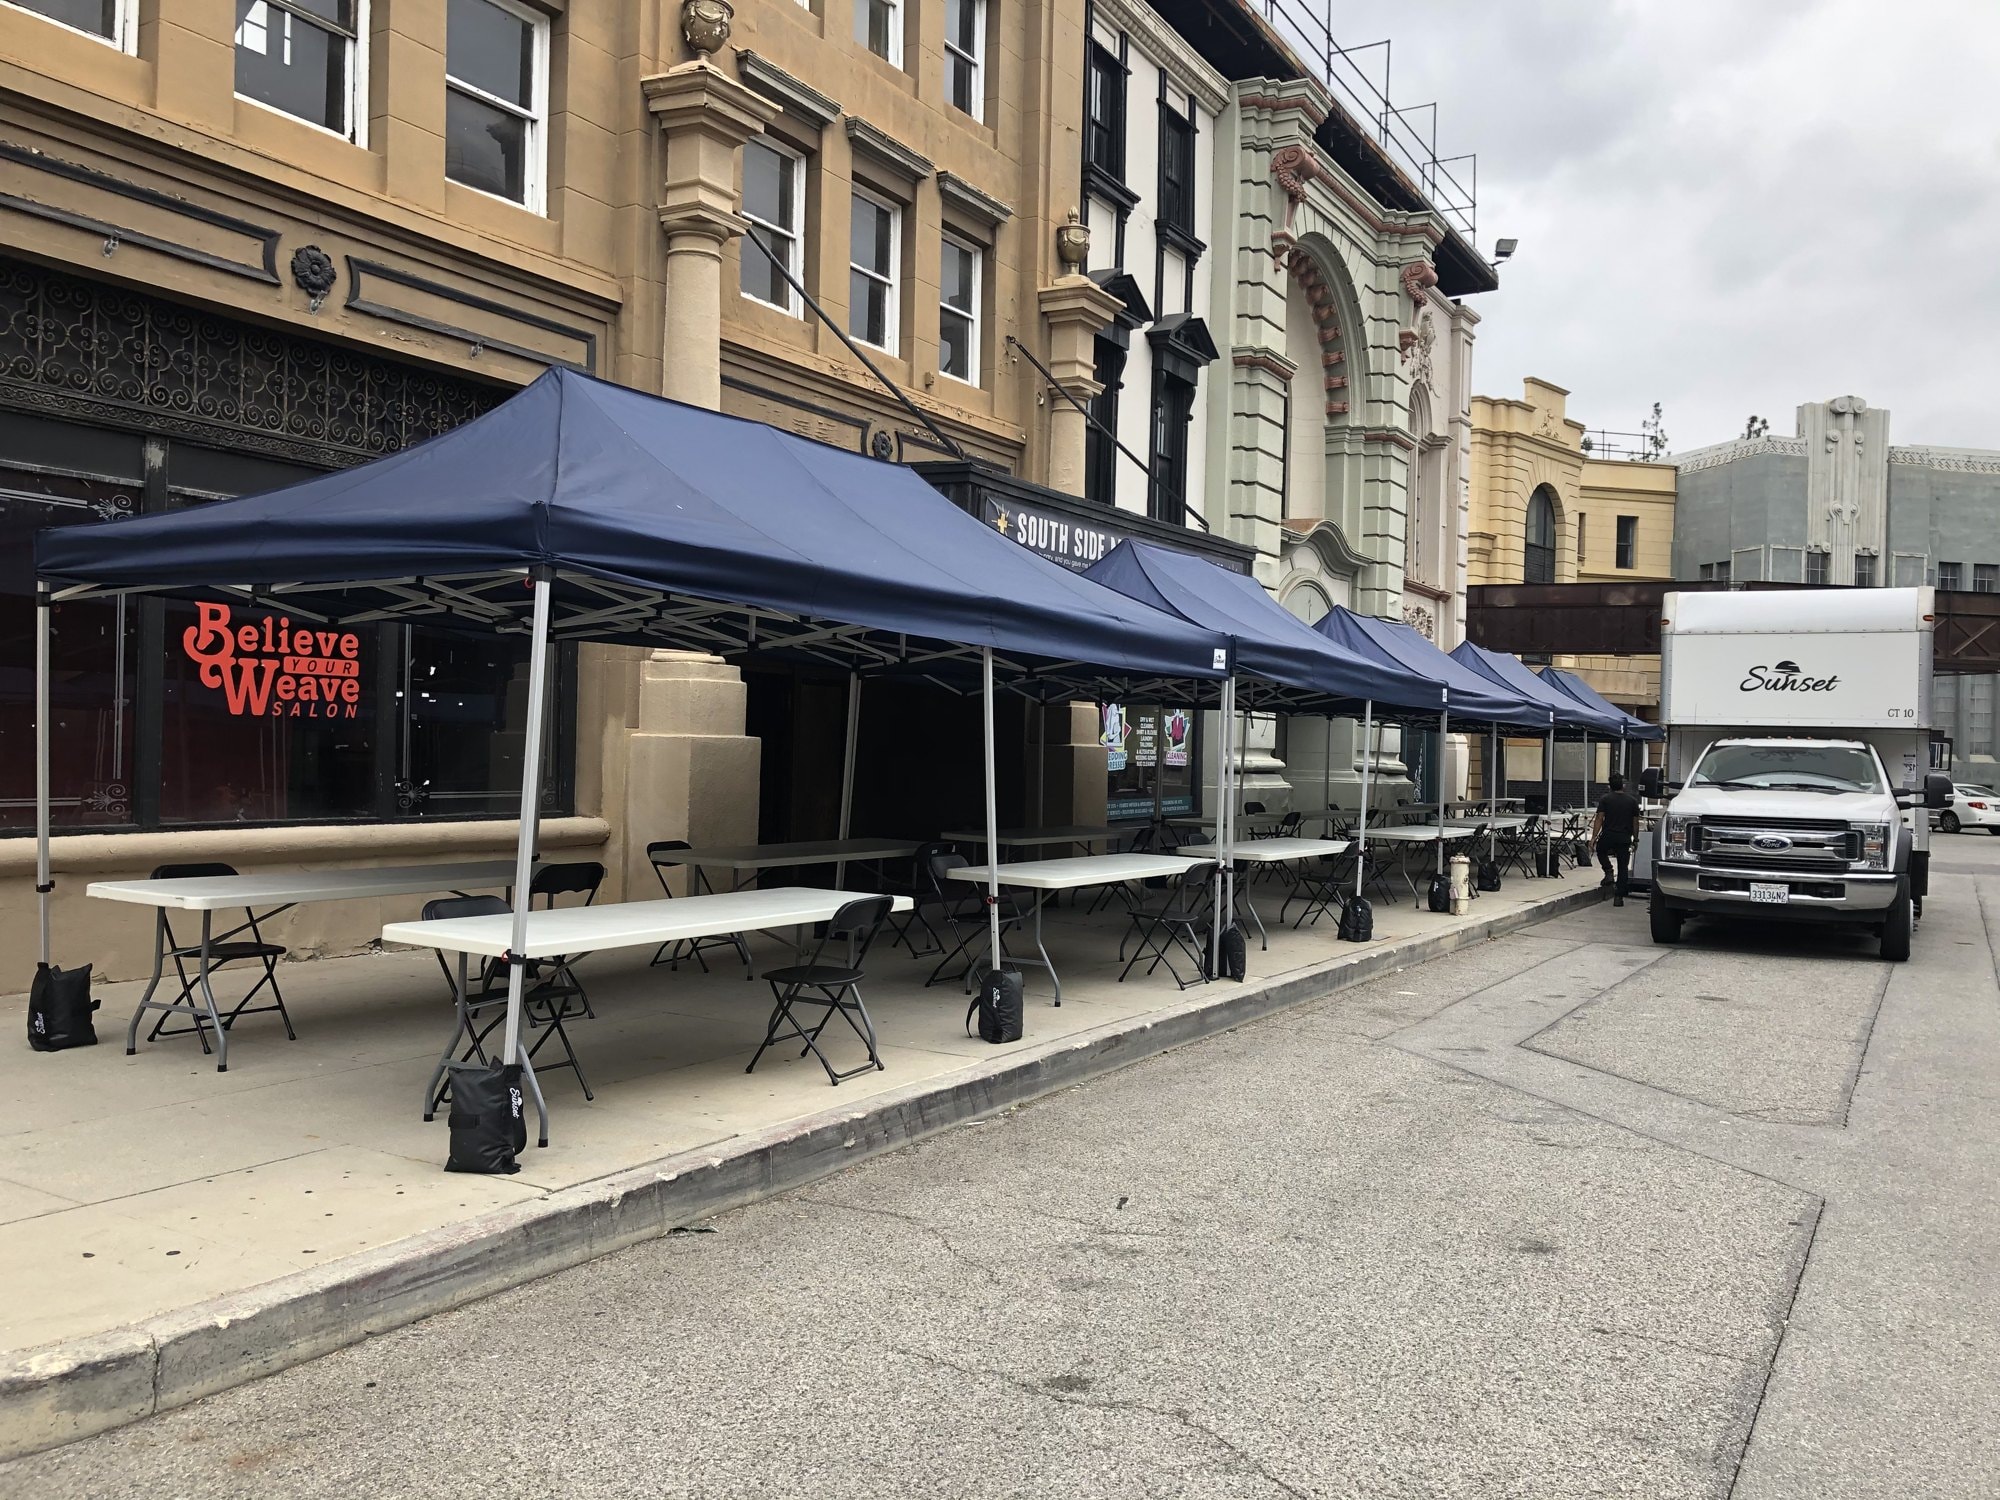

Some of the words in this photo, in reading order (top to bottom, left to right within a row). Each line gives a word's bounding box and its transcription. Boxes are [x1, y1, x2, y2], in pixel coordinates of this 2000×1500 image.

[1017, 512, 1069, 554] SOUTH
[1074, 527, 1105, 560] SIDE
[183, 601, 359, 663] Believe
[291, 658, 353, 675] YOUR
[200, 656, 360, 716] Weave
[1740, 664, 1842, 692] Sunset
[272, 701, 358, 719] SALON
[1887, 708, 1900, 718] CT
[1903, 708, 1914, 718] 10
[1108, 751, 1127, 761] EDDING
[1108, 760, 1125, 769] RESSES
[1760, 838, 1782, 848] Ford
[510, 1087, 521, 1119] Sunset
